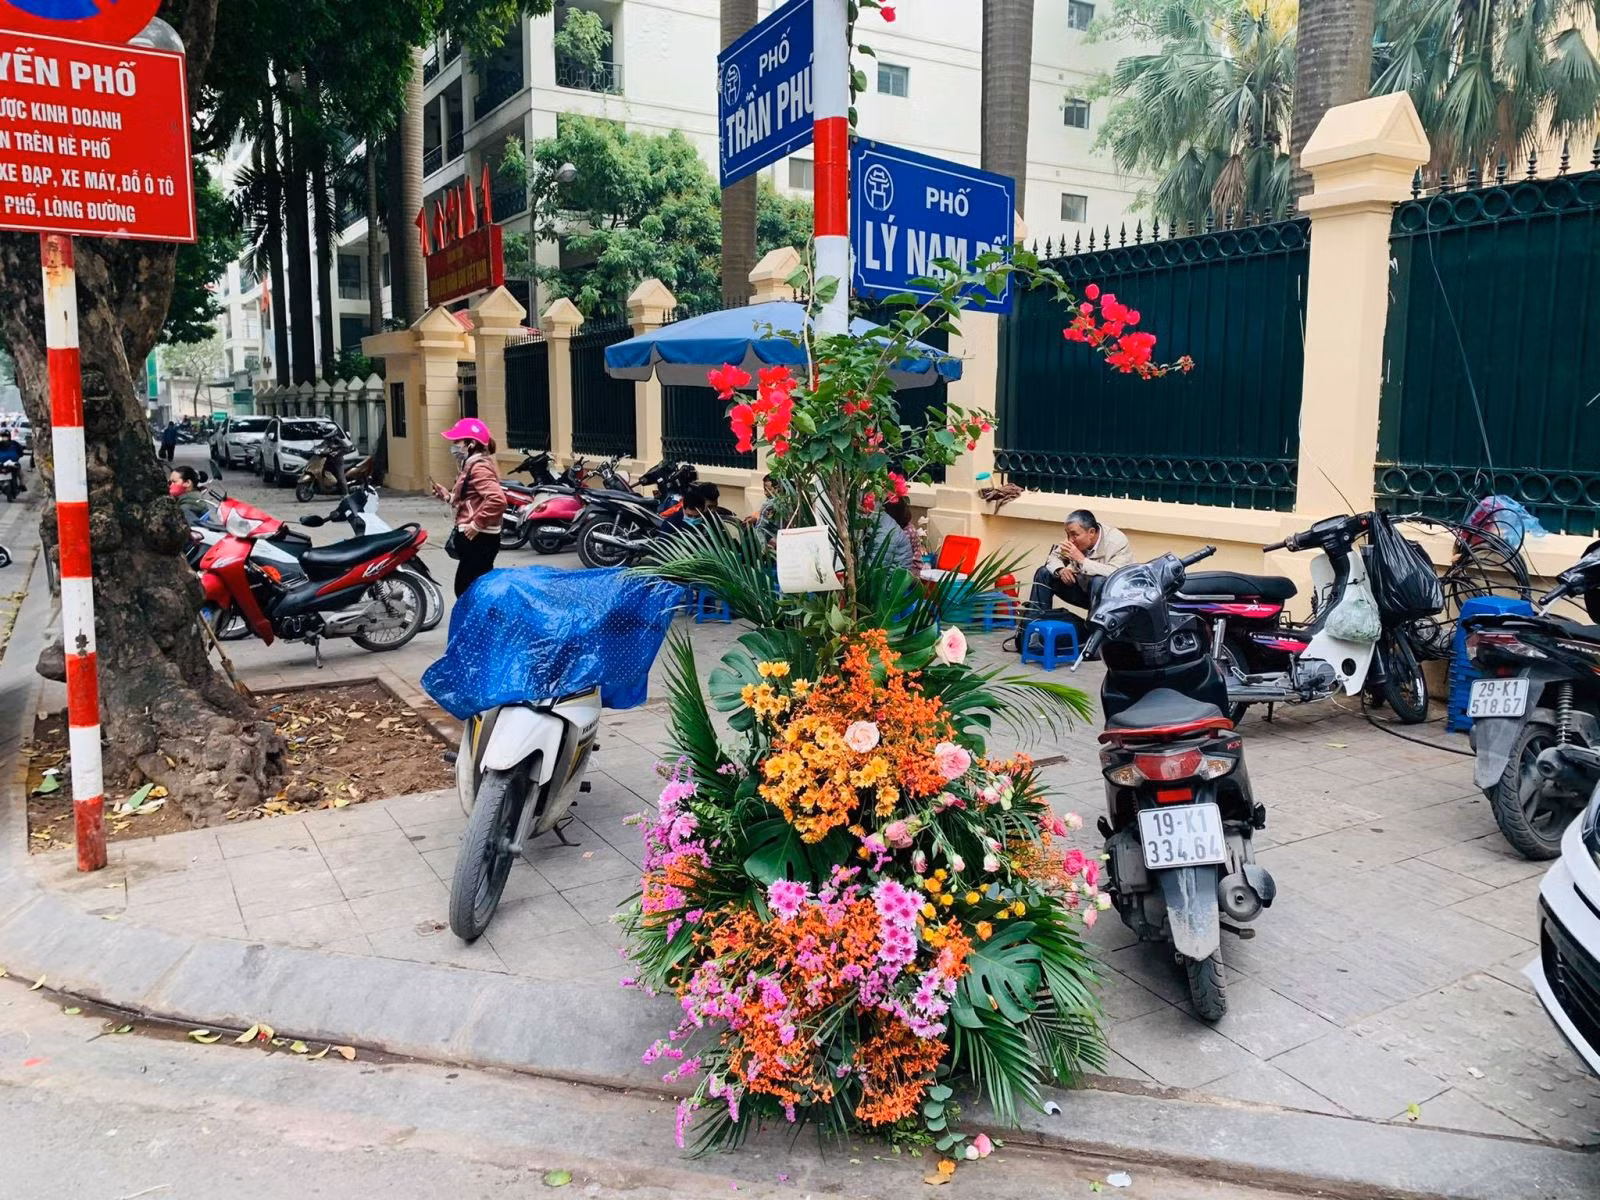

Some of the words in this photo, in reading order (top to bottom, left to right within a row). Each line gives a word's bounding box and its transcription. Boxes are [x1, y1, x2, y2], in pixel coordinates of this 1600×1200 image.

[759, 26, 791, 78] PHỐ
[70, 61, 137, 97] PHỐ
[31, 101, 68, 124] KINH
[71, 106, 122, 130] DOANH
[726, 84, 771, 159] TRẦN
[777, 52, 814, 131] PHÚ
[14, 130, 54, 154] TRÊN
[57, 133, 78, 156] HÈ
[81, 137, 111, 159] PHỐ
[0, 162, 18, 182] XE
[61, 168, 81, 188] XE
[144, 172, 154, 195] Ô
[157, 175, 175, 196] TÔ
[44, 195, 84, 219] LÒNG
[87, 199, 137, 223] ĐƯỜNG
[926, 186, 971, 217] PHỐ
[865, 214, 898, 272] LÝ
[907, 228, 968, 282] NAM
[1478, 681, 1519, 698] 29-K1
[1471, 698, 1522, 715] 518.67
[1153, 808, 1208, 836] 19-K1
[1148, 835, 1221, 864] 334.64
